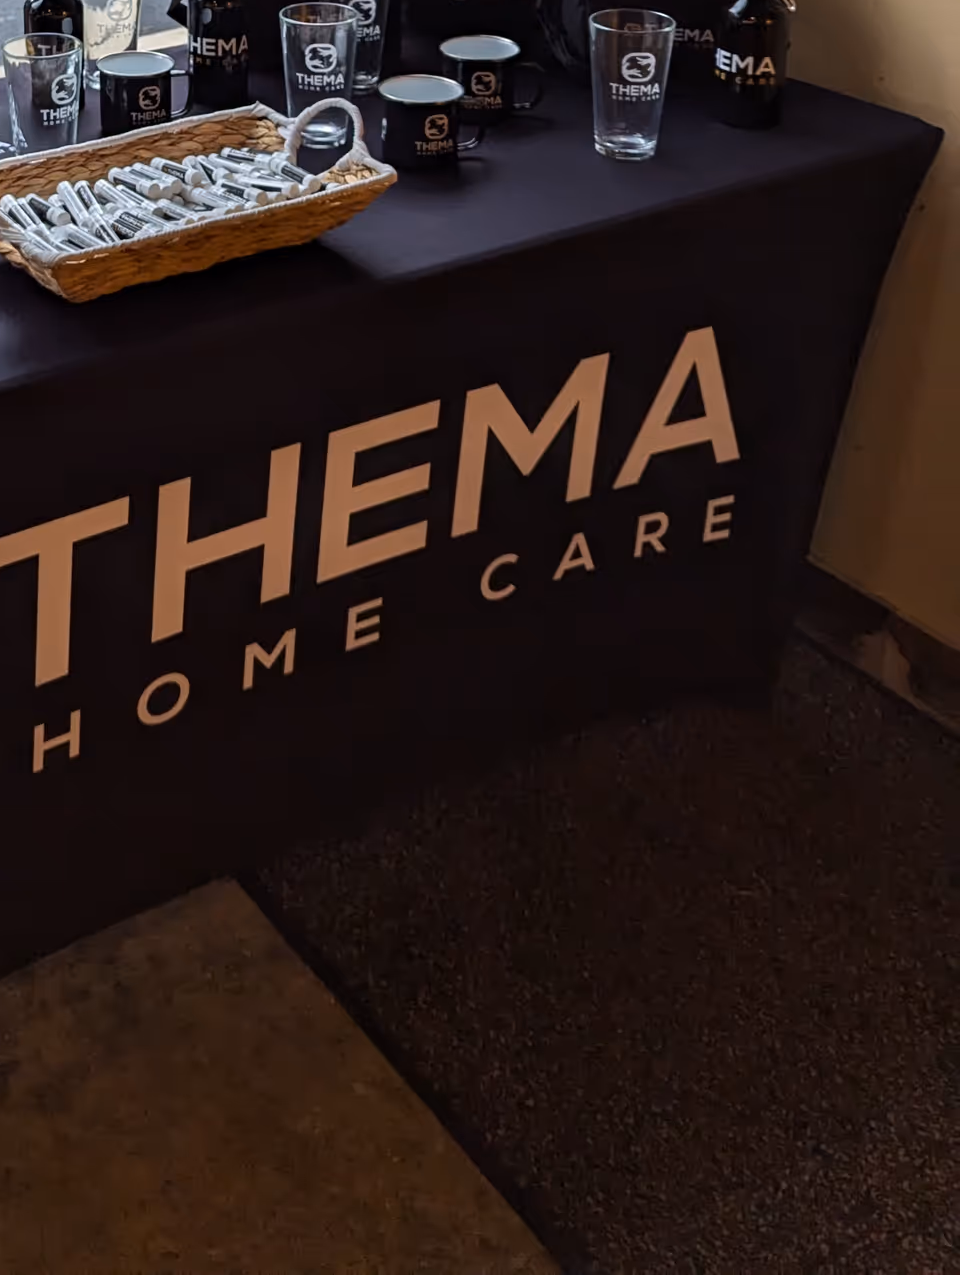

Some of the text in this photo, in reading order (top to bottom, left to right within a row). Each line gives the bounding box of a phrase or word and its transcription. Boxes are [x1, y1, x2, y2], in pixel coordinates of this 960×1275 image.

[357, 25, 381, 37] EMA
[673, 28, 714, 42] EMA
[190, 34, 249, 56] HEMA
[715, 48, 776, 76] EMA
[296, 72, 345, 86] THEMA
[609, 82, 660, 96] THEMA
[131, 109, 167, 121] THEMA
[415, 138, 454, 152] THEMA
[32, 493, 736, 774] HOME CARE
